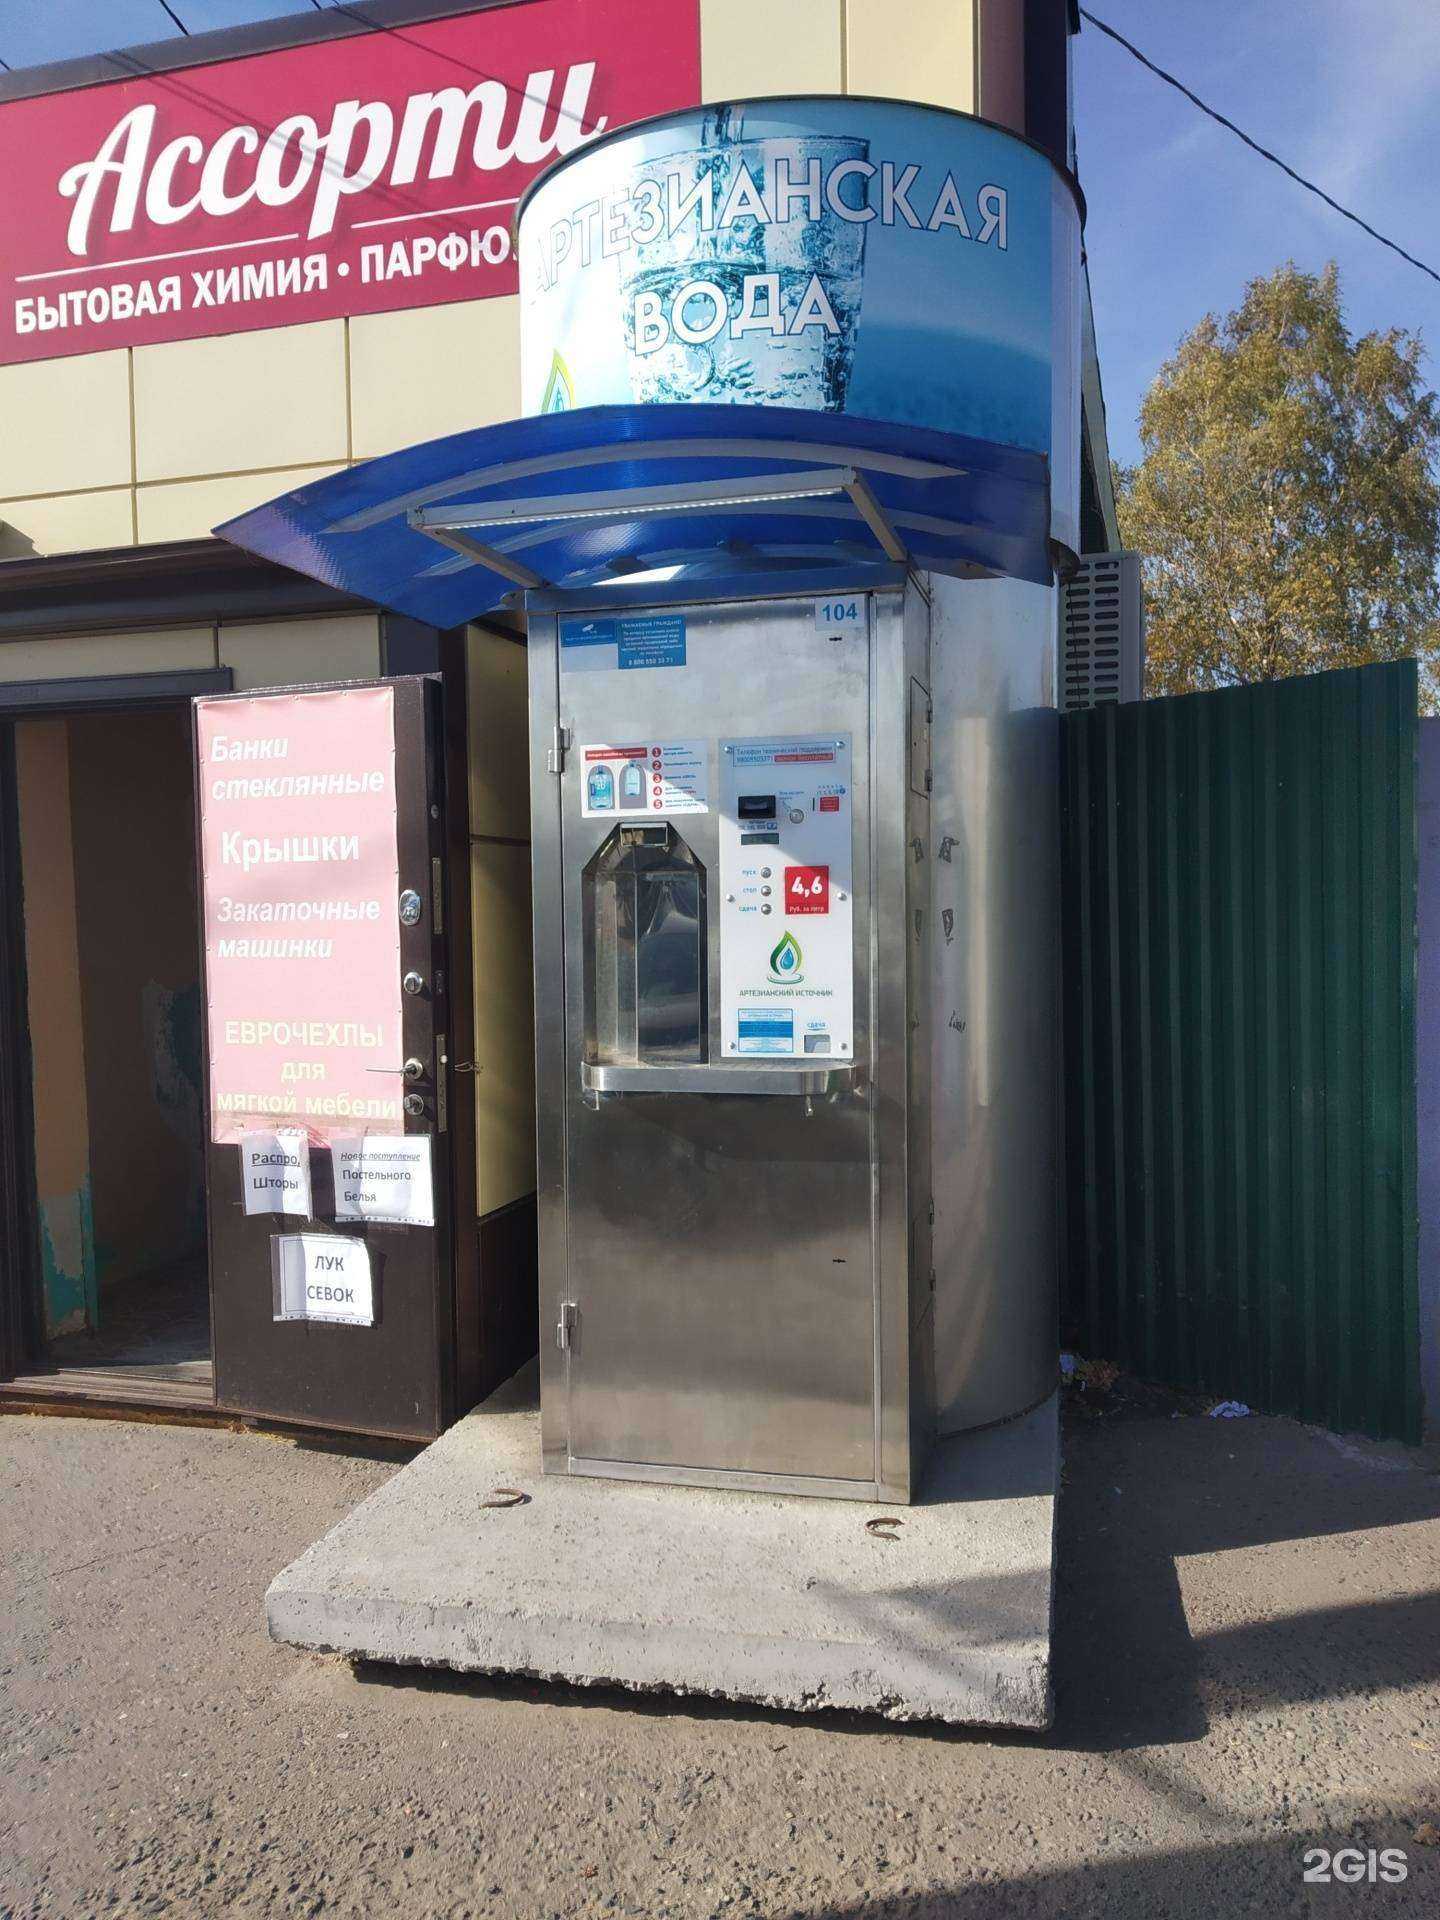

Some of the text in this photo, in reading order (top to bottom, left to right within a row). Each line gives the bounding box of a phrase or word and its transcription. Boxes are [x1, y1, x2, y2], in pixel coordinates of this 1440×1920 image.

[58, 61, 608, 256] Ассорти
[534, 157, 1008, 292] АРТЕЗИАНСКАЯ
[14, 225, 518, 334] БЫТОВАЯ ХИМИЯ ПАРФЮ
[634, 273, 841, 357] ВОДА
[822, 602, 858, 622] 104
[210, 735, 289, 763] Банки
[212, 770, 385, 800] стеклянные
[221, 831, 360, 872] Крышки
[791, 876, 823, 898] 4,6
[216, 896, 381, 922] Закаточные
[217, 938, 333, 958] машинки
[224, 1020, 384, 1048] ЕВРОЧЕХЛЫ
[217, 1090, 397, 1119] мягкой мебели
[368, 1152, 421, 1162] поступление
[253, 1177, 299, 1191] Шторы
[342, 1169, 411, 1180] Постельного
[344, 1190, 377, 1202] Белья
[314, 1255, 344, 1271] ЛУК
[306, 1285, 354, 1303] СЕВОК
